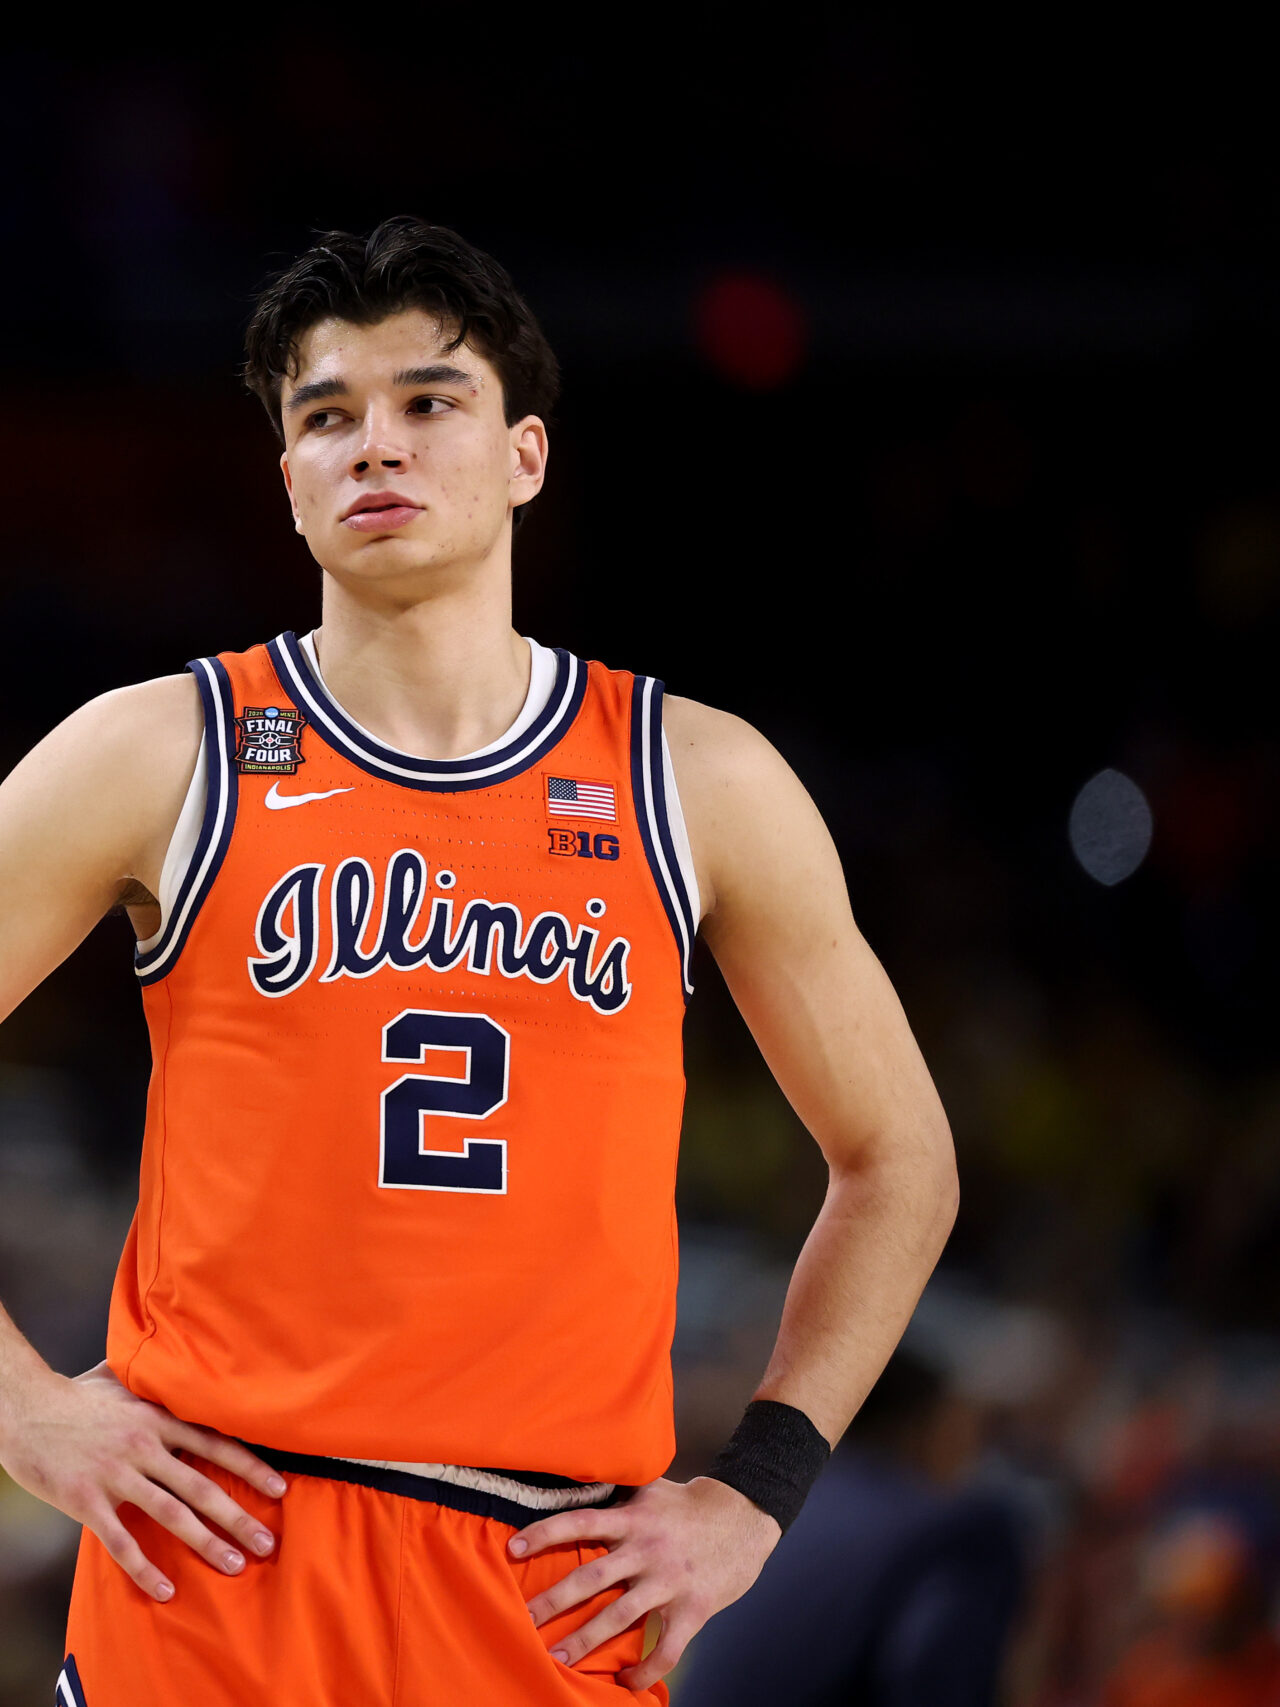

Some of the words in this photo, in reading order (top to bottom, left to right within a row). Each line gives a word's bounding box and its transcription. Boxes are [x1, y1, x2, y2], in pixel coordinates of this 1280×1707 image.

[245, 748, 291, 762] FOUR
[246, 720, 293, 733] FINAL
[247, 848, 632, 1016] Illinois
[378, 1008, 510, 1195] 2
